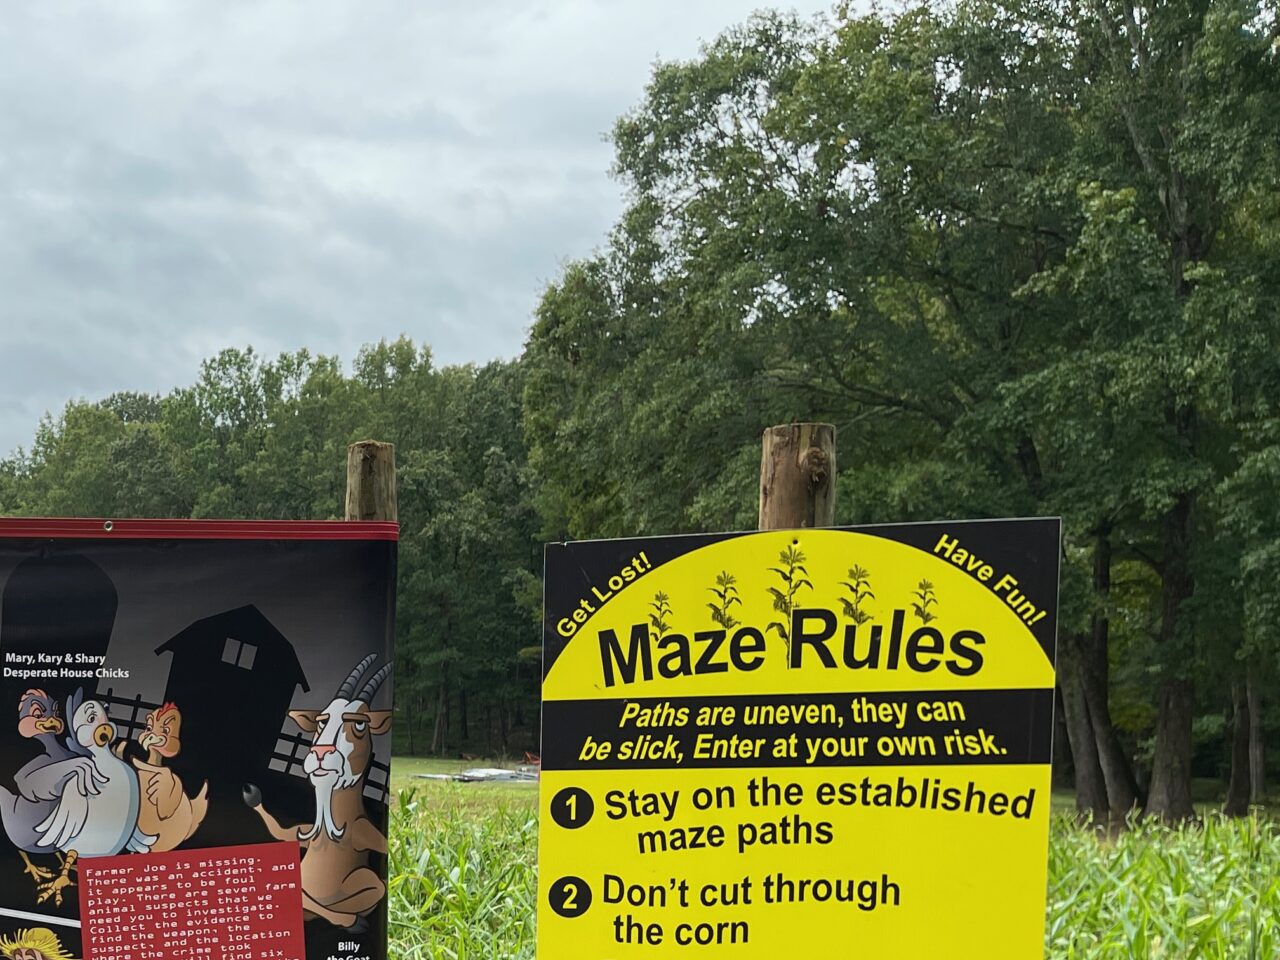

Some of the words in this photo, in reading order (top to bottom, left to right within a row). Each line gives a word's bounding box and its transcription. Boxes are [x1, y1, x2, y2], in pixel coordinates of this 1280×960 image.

[557, 598, 595, 637] Get
[591, 551, 651, 602] Lost!
[934, 534, 993, 580] Have
[993, 574, 1046, 626] Fun!
[5, 653, 35, 665] Mary,
[38, 653, 63, 665] Kary
[64, 653, 73, 663] &
[75, 653, 106, 665] Shary
[598, 622, 766, 688] Maze
[790, 608, 986, 676] Rules
[4, 667, 58, 679] Desperate
[60, 668, 94, 678] House
[95, 668, 129, 678] Chicks
[619, 702, 690, 728] Paths
[696, 707, 733, 726] are
[744, 702, 844, 730] uneven,
[851, 698, 907, 728] they
[917, 701, 965, 721] can
[579, 736, 609, 762] be
[617, 735, 684, 764] slick,
[693, 733, 765, 758] Enter
[772, 735, 798, 757] at
[805, 737, 866, 764] your
[876, 737, 936, 756] own
[944, 729, 1007, 755] risk.
[565, 795, 577, 820] 1
[605, 788, 679, 821] Stay
[693, 785, 735, 809] on
[748, 776, 803, 806] the
[816, 777, 1035, 820] established
[638, 824, 724, 854] maze
[738, 815, 834, 853] paths
[86, 867, 134, 877] Farmer
[176, 862, 190, 870] is
[200, 857, 261, 867] missing.
[87, 878, 127, 886] There
[192, 867, 262, 878] accident,
[272, 862, 295, 871] and
[88, 888, 103, 896] it
[112, 884, 167, 894] appears
[225, 876, 255, 884] foul
[88, 897, 126, 907] play.
[136, 892, 176, 901] There
[185, 890, 208, 898] are
[217, 886, 256, 895] seven
[266, 883, 296, 891] farm
[563, 884, 577, 909] 2
[700, 876, 752, 906] cut
[763, 874, 901, 911] through
[338, 941, 360, 953] Billy
[614, 915, 663, 945] the
[675, 920, 749, 947] corn
